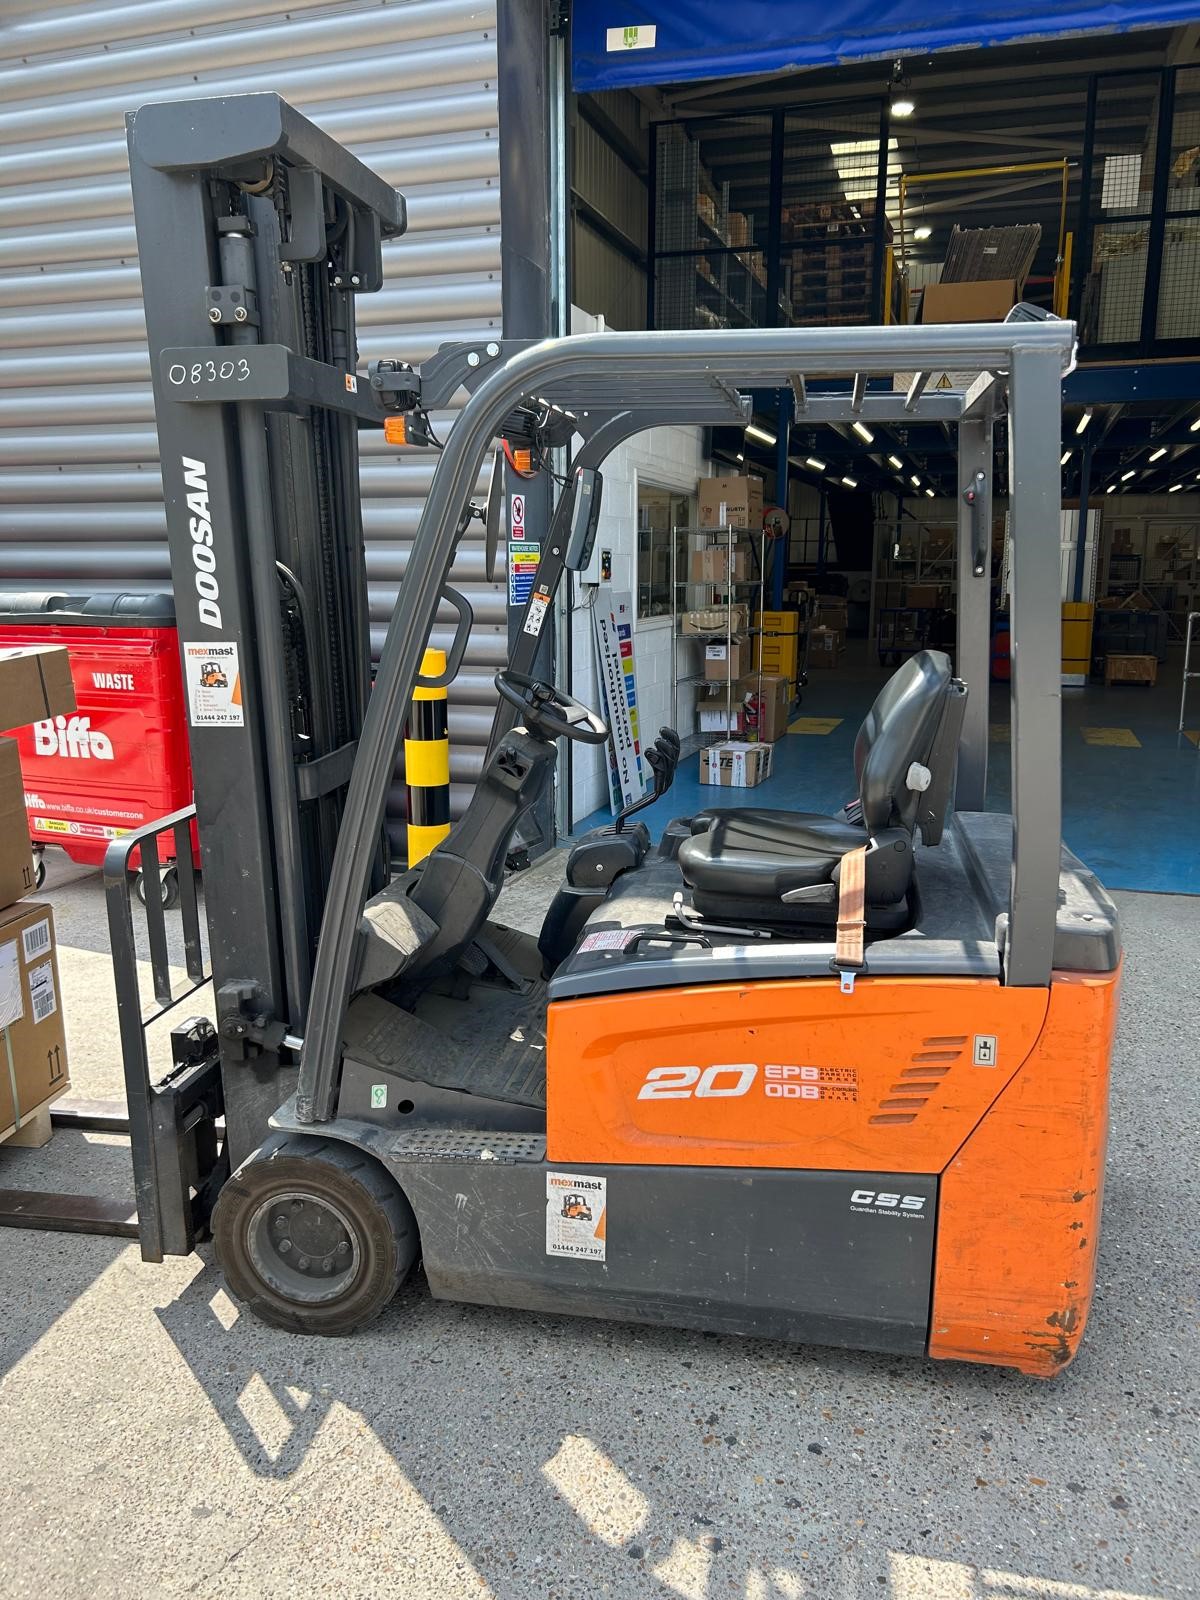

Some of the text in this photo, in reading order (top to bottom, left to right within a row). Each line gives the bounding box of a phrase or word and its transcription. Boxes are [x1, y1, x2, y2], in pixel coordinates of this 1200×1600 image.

[169, 358, 251, 385] 08303
[182, 455, 223, 629] DOOSAN
[188, 646, 235, 656] mexmast
[92, 672, 135, 690] WASTE
[599, 619, 624, 751] unauthorised
[611, 652, 632, 748] personnel
[34, 715, 115, 760] Biffa
[621, 756, 630, 785] No
[46, 803, 144, 820] www.biffa.co.uk/customerzone
[637, 1063, 758, 1099] 20
[764, 1064, 819, 1080] EPB
[764, 1083, 819, 1099] ODB
[550, 1178, 602, 1190] mexmast
[850, 1189, 926, 1210] GSS
[850, 1205, 925, 1219] Guardian Stability System
[552, 1243, 574, 1252] 01444
[589, 1247, 602, 1255] 197
